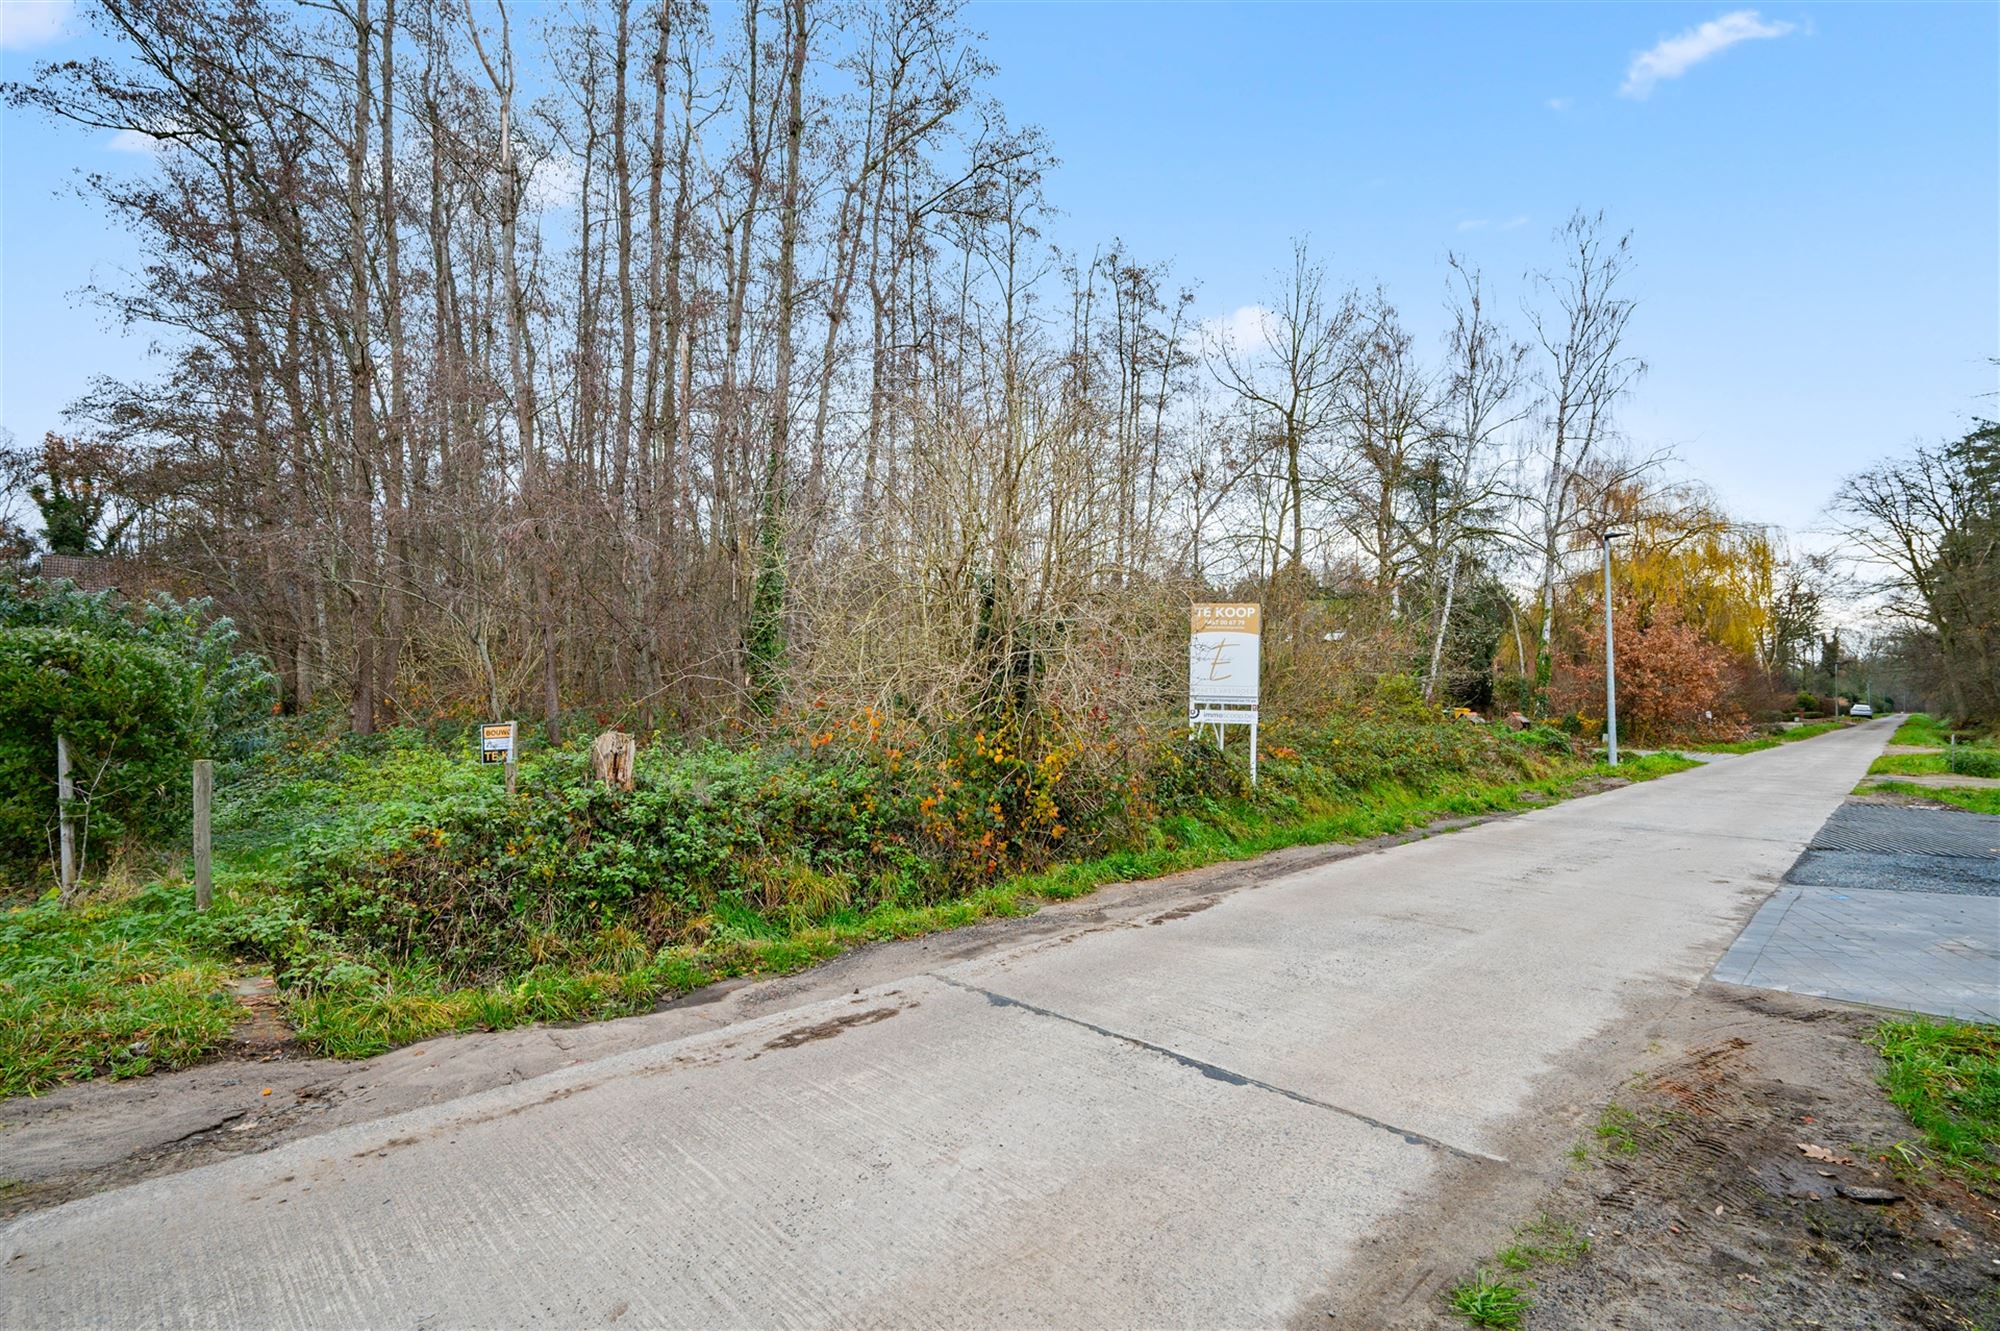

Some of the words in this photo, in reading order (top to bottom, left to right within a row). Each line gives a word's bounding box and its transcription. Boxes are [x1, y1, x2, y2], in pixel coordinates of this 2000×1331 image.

[1195, 607, 1211, 617] TE
[1216, 607, 1255, 618] KOOP
[484, 751, 498, 761] TE
